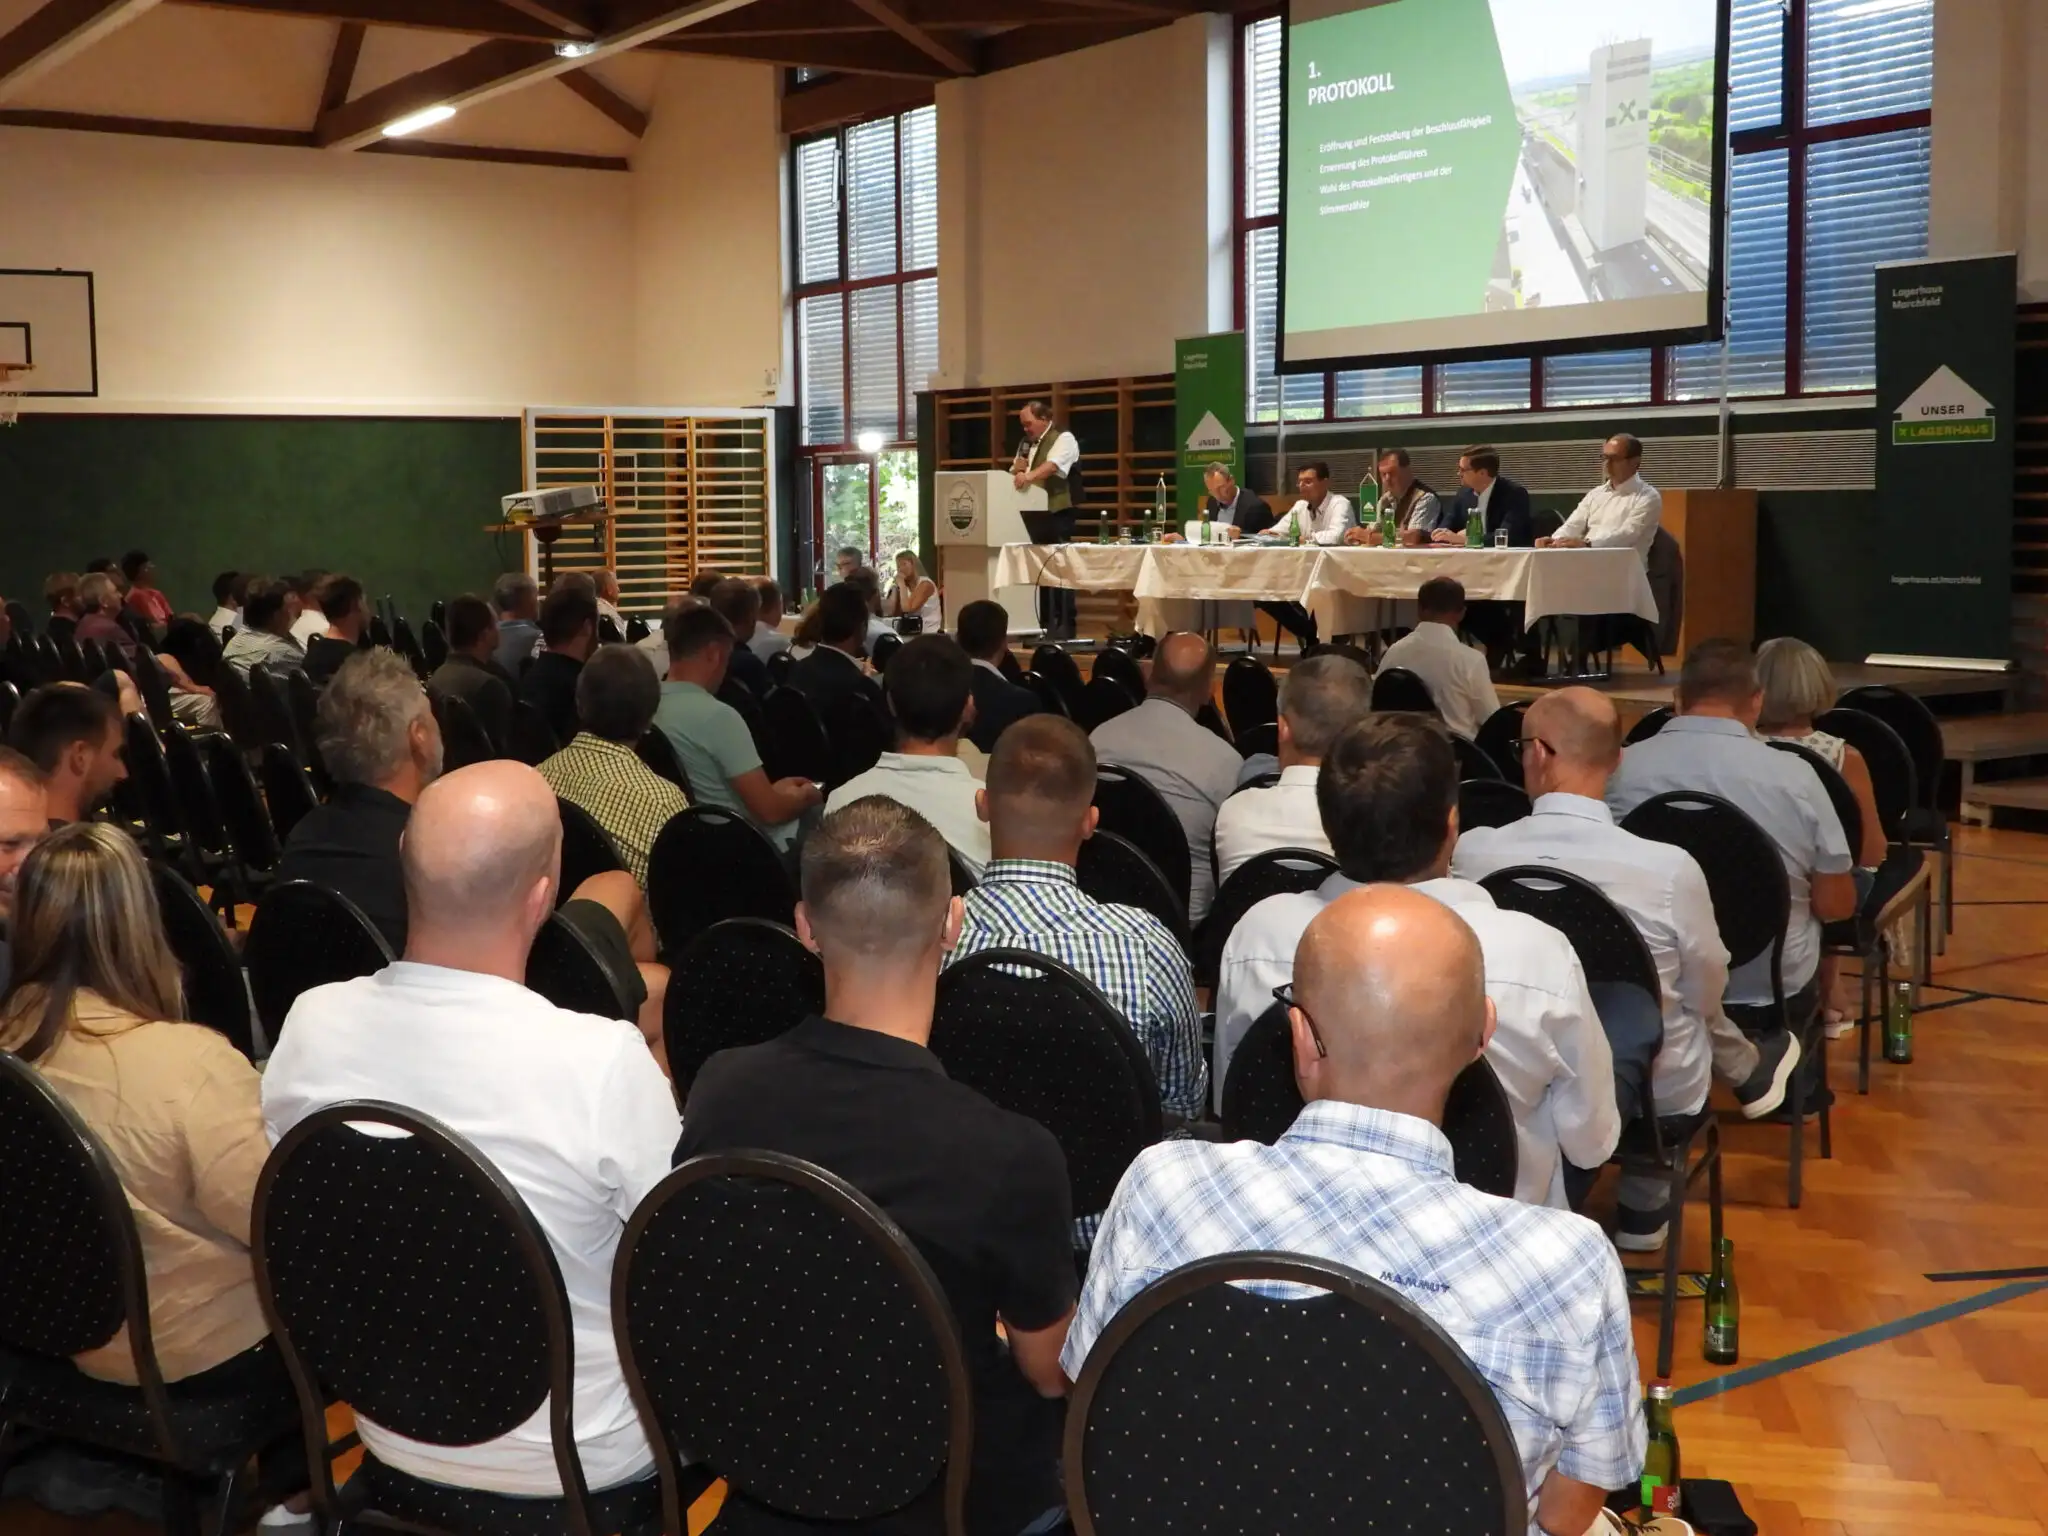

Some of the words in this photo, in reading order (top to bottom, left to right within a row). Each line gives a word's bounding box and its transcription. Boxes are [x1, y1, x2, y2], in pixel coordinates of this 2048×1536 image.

[1308, 61, 1321, 79] 1.
[1308, 72, 1395, 106] PROTOKOLL
[1319, 138, 1353, 154] Eröffnung
[1354, 135, 1368, 148] und
[1369, 129, 1410, 145] Feststellung
[1411, 126, 1424, 139] der
[1319, 159, 1356, 174] Ernennung
[1357, 156, 1370, 168] des
[1371, 148, 1428, 165] Protokollführers
[1319, 182, 1337, 195] Wahl
[1424, 167, 1438, 180] und
[1440, 164, 1453, 176] der
[1319, 199, 1370, 216] Stimmenzähler
[1892, 286, 1943, 298] Lagerhaus
[1892, 297, 1941, 309] Marchfeld
[1921, 404, 1965, 416] UNSER
[1911, 424, 1988, 436] LAGERHAUS
[1379, 1271, 1450, 1292] MAMMUT
